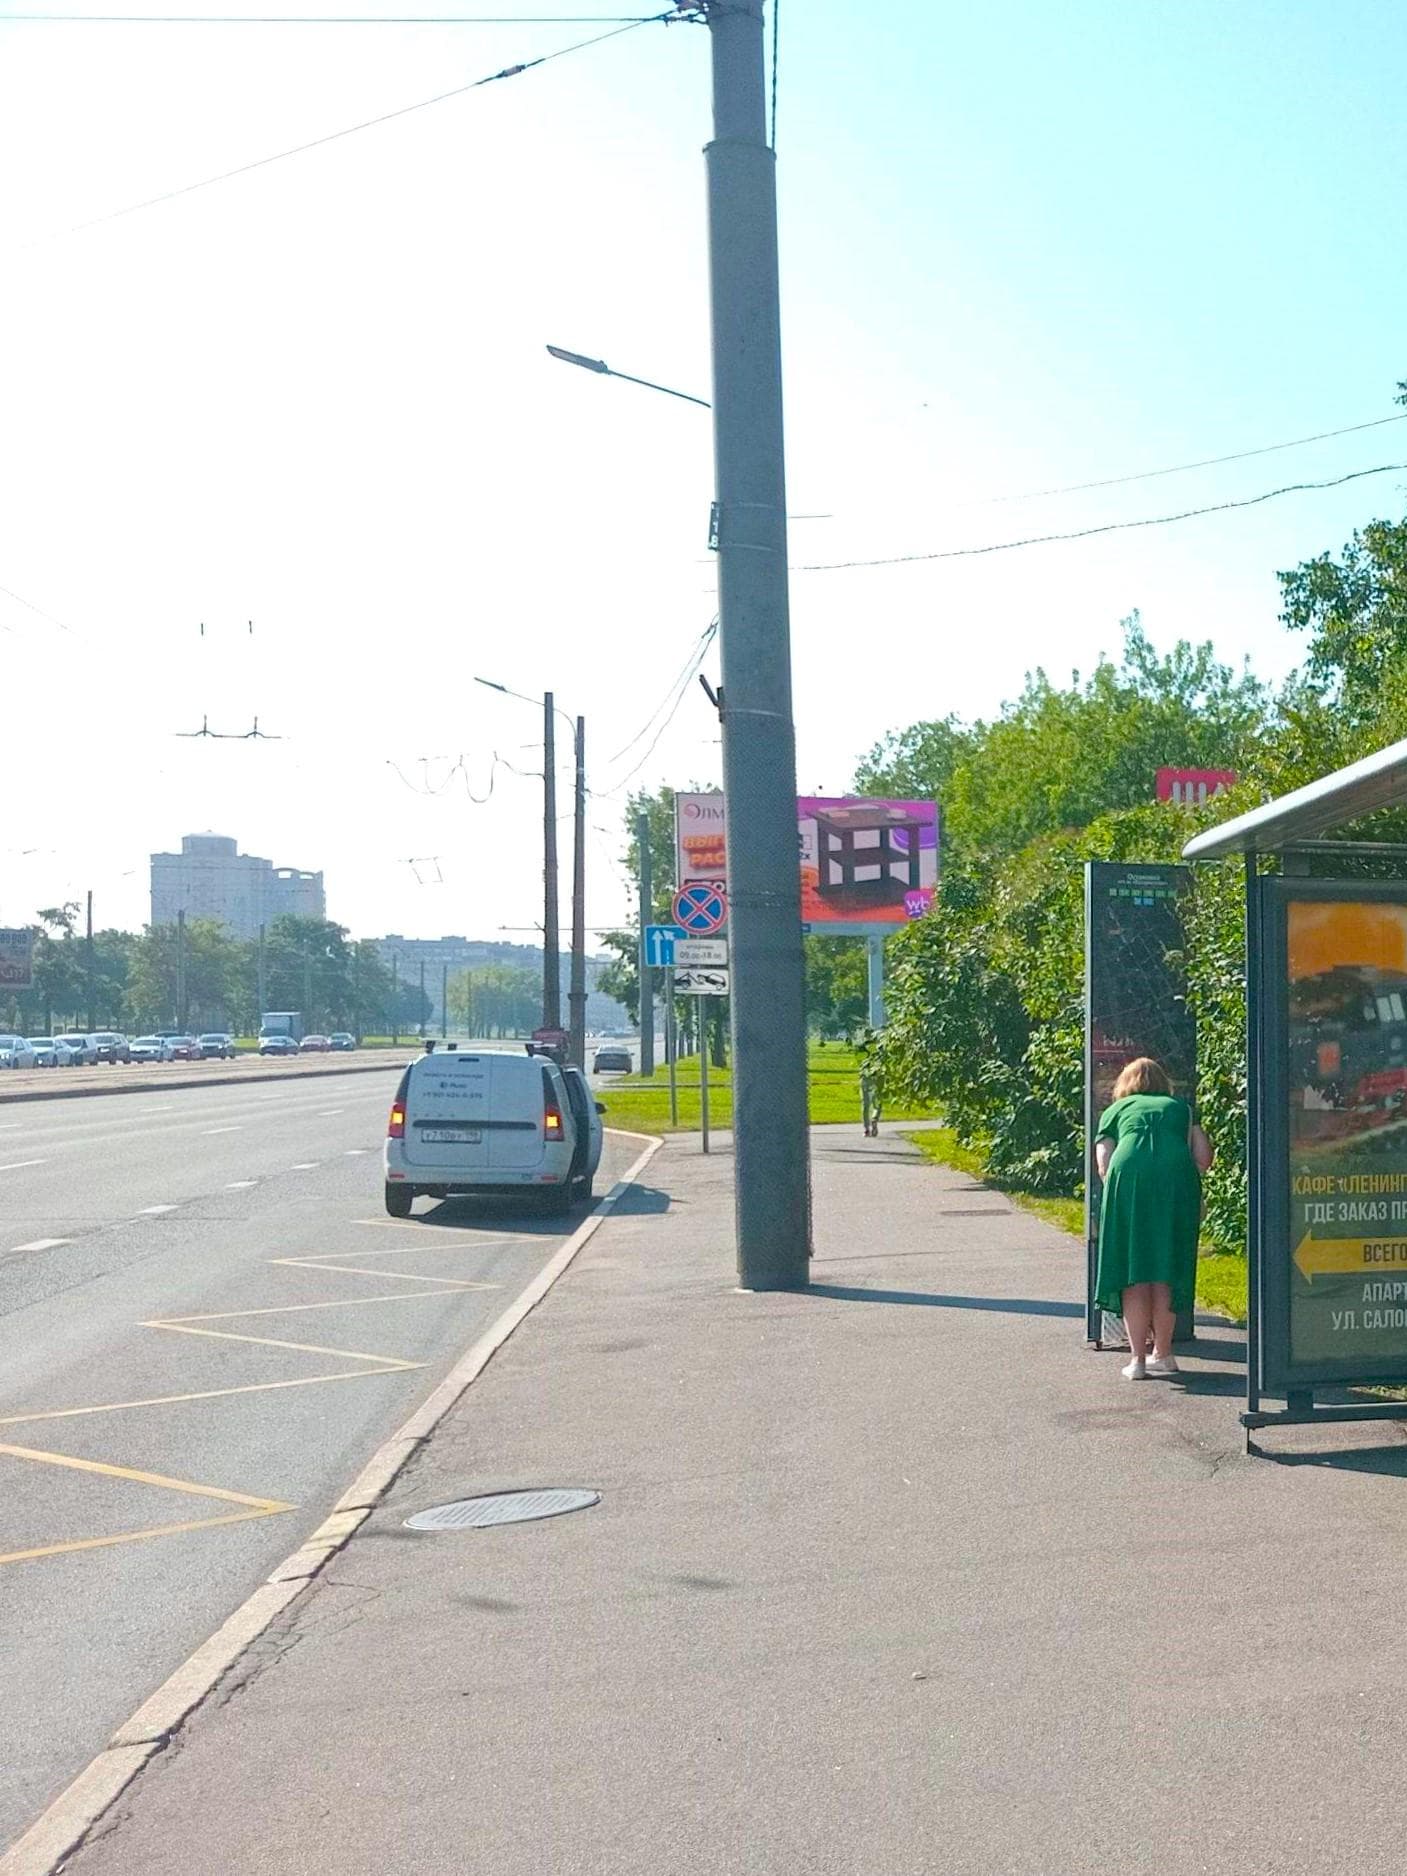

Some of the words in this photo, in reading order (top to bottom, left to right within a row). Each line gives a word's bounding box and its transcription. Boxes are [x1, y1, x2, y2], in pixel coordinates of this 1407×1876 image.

[1292, 1175, 1335, 1195] КАФЕ
[1304, 1203, 1335, 1224] ГДЕ
[1338, 1201, 1387, 1221] ЗАКАЗ
[1363, 1243, 1407, 1262] ВСЕГО
[1331, 1310, 1360, 1330] УЛ.
